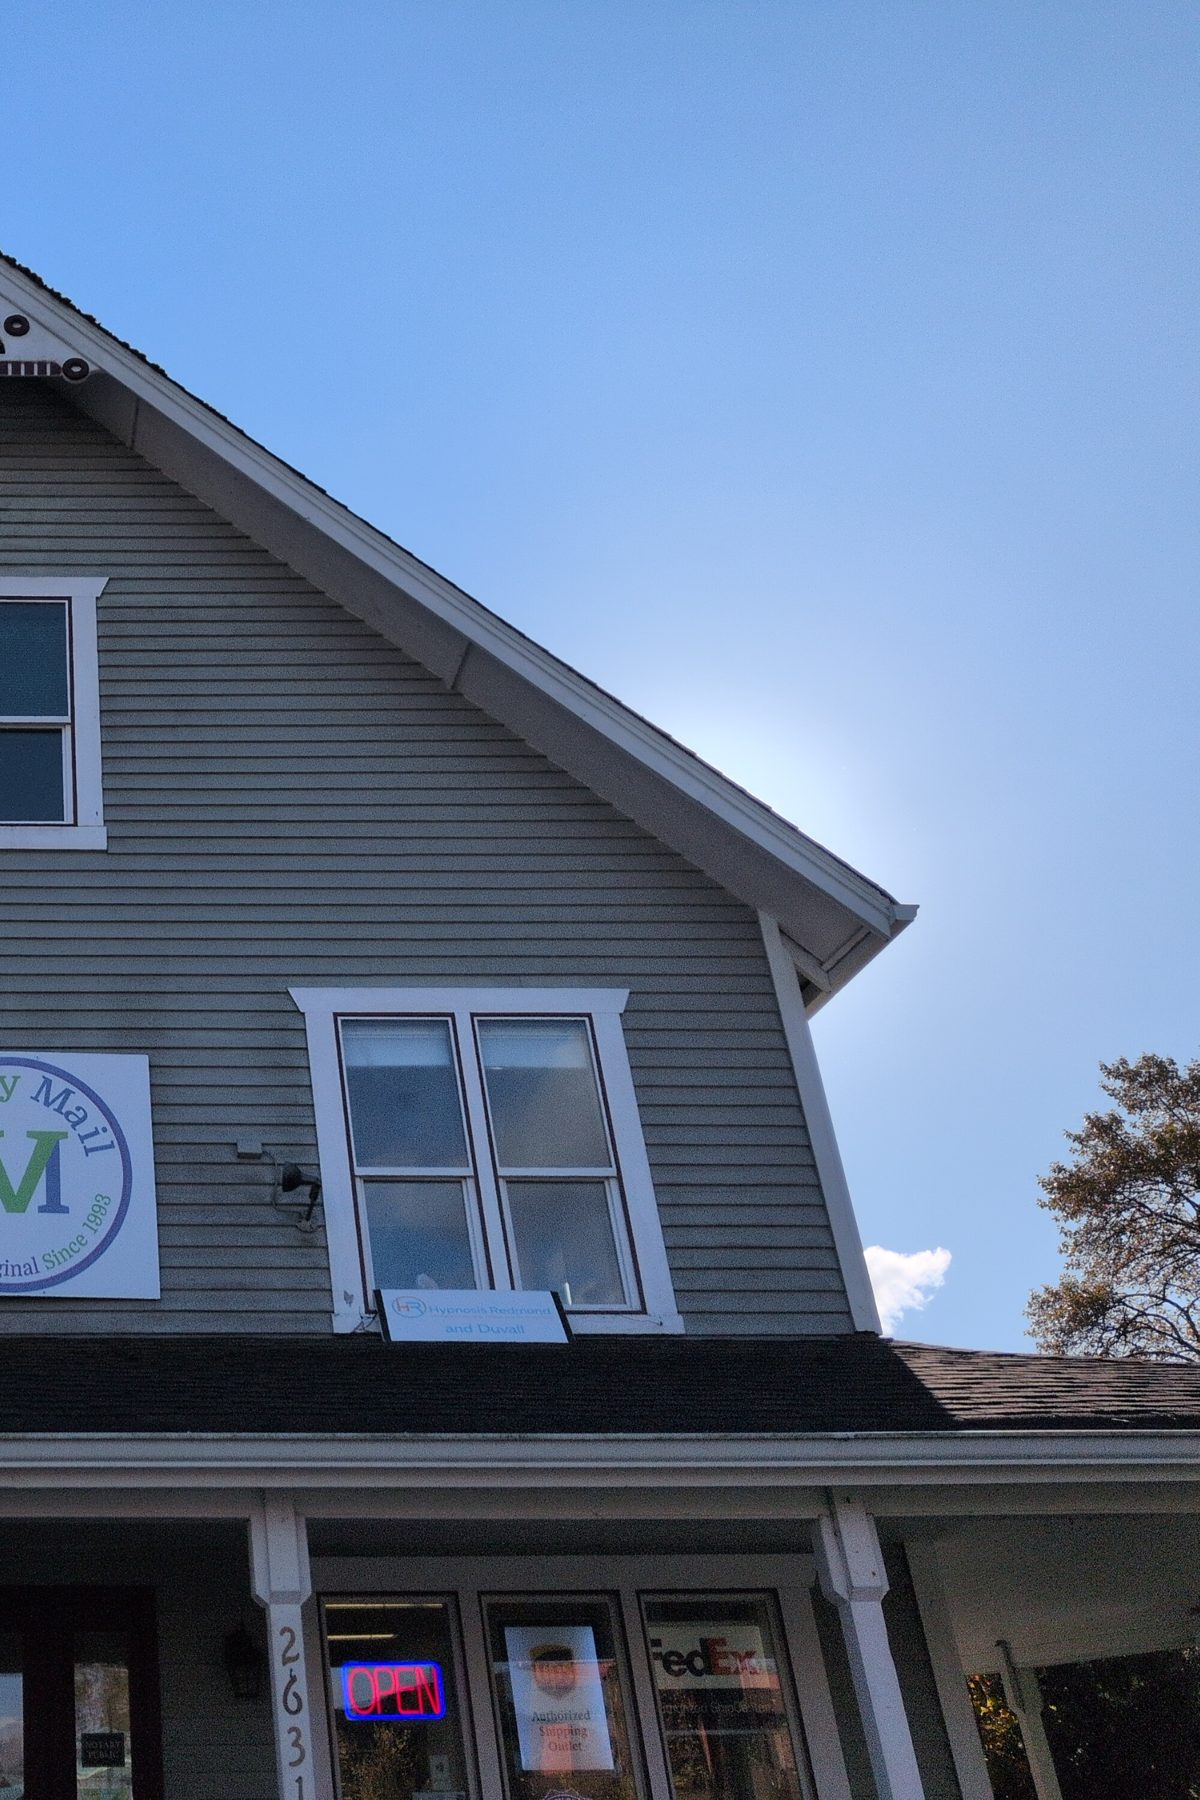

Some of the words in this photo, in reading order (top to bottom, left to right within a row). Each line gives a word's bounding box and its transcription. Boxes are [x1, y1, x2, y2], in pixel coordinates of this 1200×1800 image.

[30, 1075, 115, 1157] Mail
[42, 1234, 88, 1270] Since
[82, 1193, 112, 1234] 1993
[429, 1305, 487, 1315] Hypnosis
[490, 1305, 550, 1315] Redmond
[446, 1324, 473, 1334] and
[478, 1324, 525, 1334] Duvall
[348, 1665, 442, 1716] OPEN
[532, 1710, 591, 1722] Authorized
[539, 1725, 588, 1739] Shipping
[549, 1741, 582, 1752] Outlet
